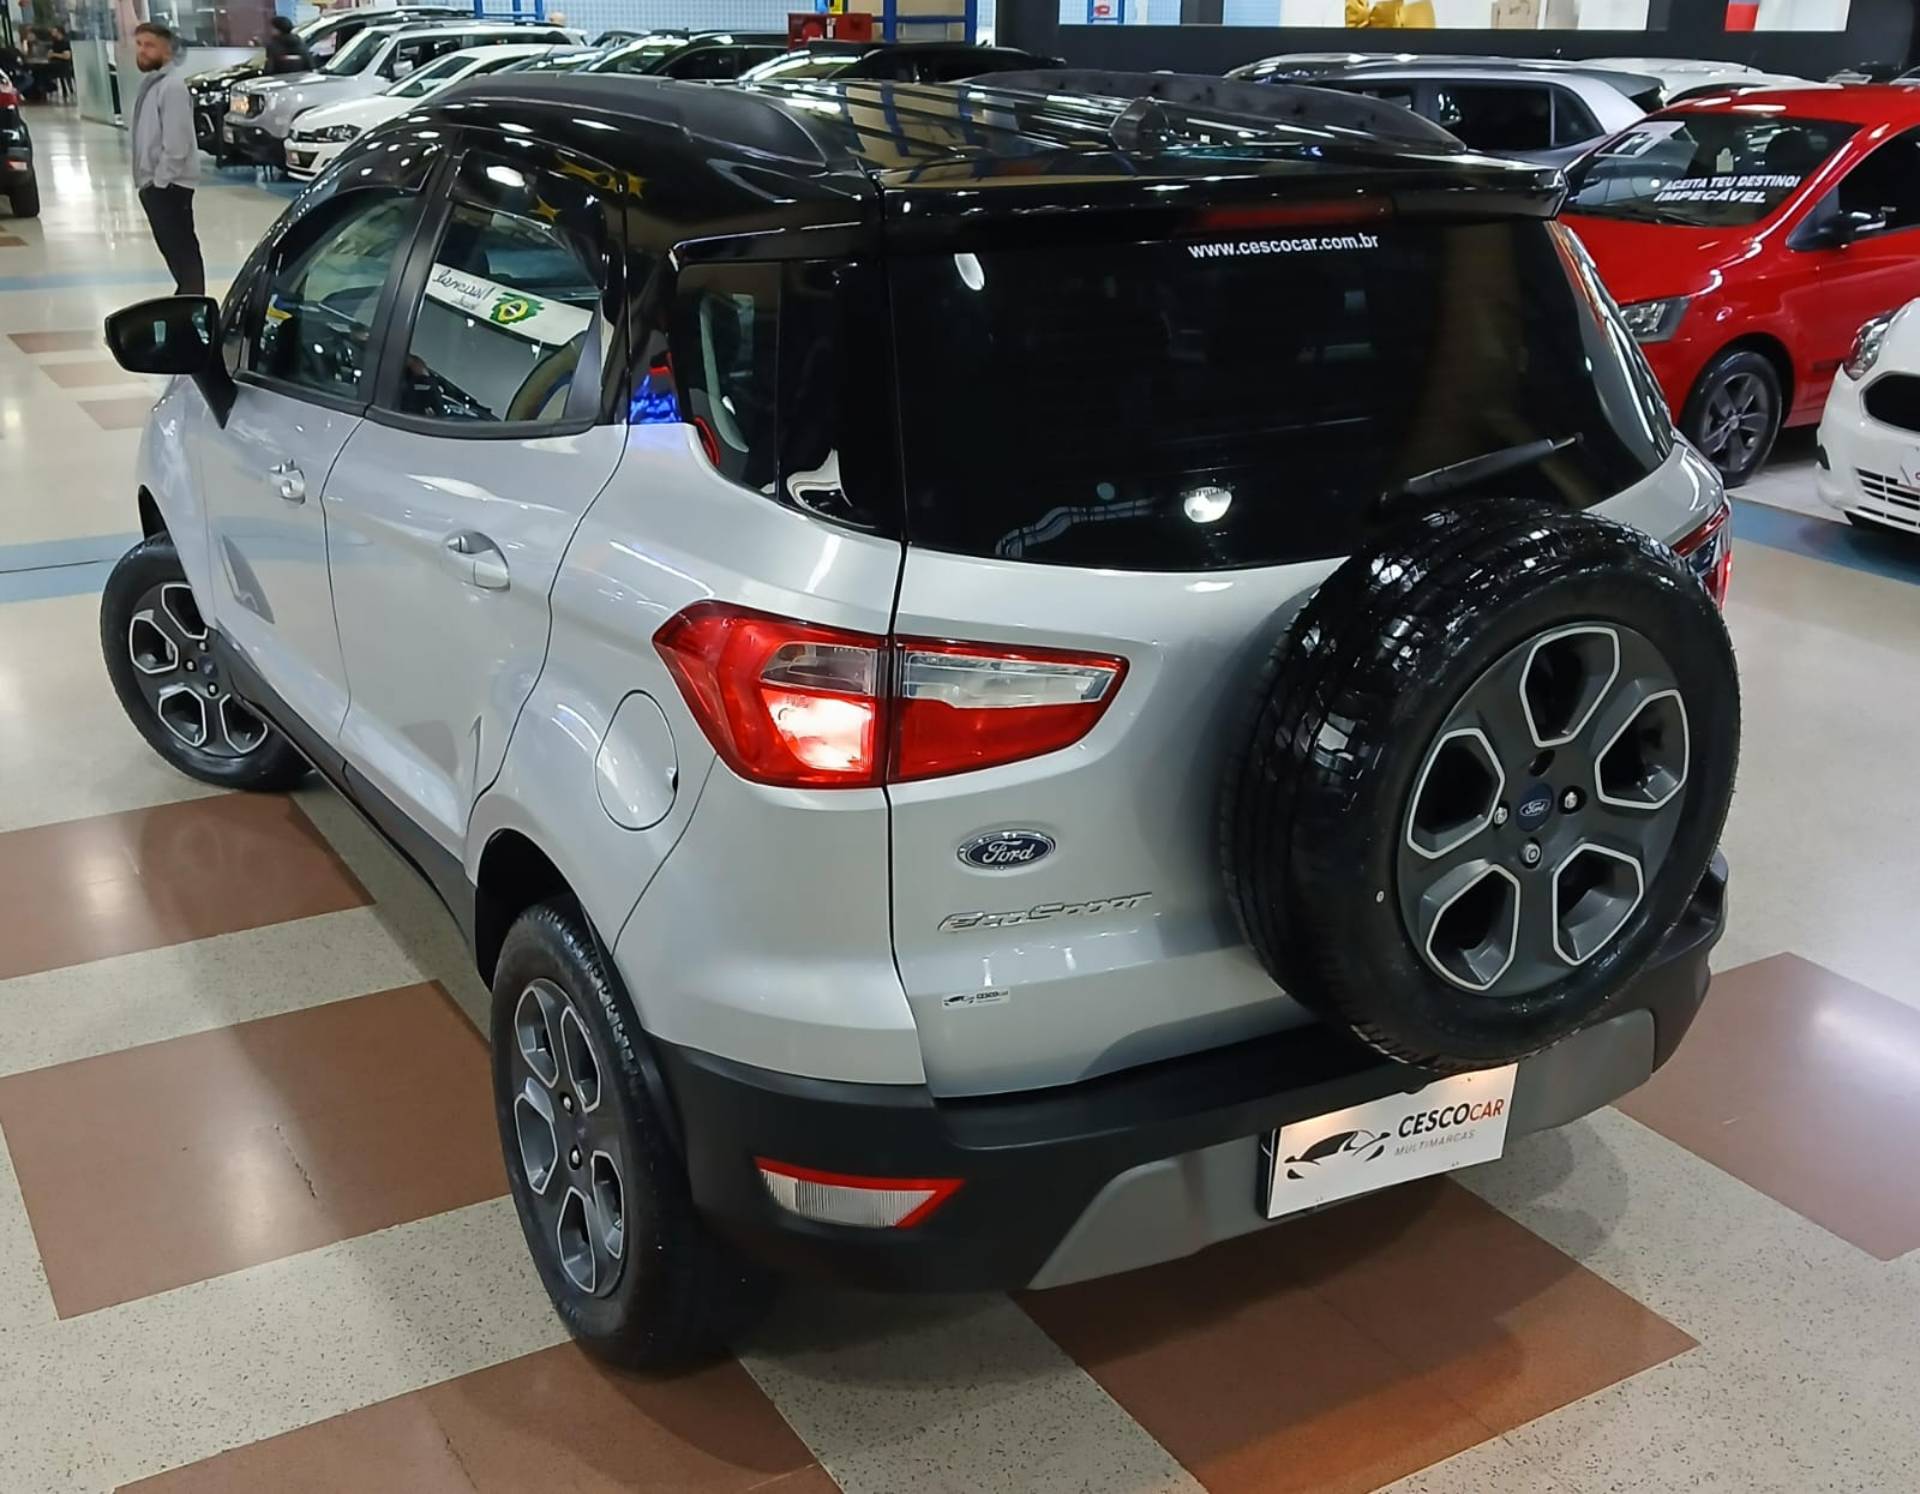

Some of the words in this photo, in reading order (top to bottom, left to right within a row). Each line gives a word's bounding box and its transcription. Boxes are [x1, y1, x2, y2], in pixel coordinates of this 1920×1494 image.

[1661, 177, 1707, 190] ACEITA
[1709, 176, 1736, 188] TEU
[1737, 174, 1801, 188] DESTINO!
[1653, 187, 1767, 203] IMPECÁVEL
[1187, 232, 1380, 259] www.cescocar.com.br
[982, 840, 1035, 864] Ford
[1398, 1098, 1505, 1138] CESCOCAR
[1394, 1128, 1477, 1156] MULTIMARCAS
